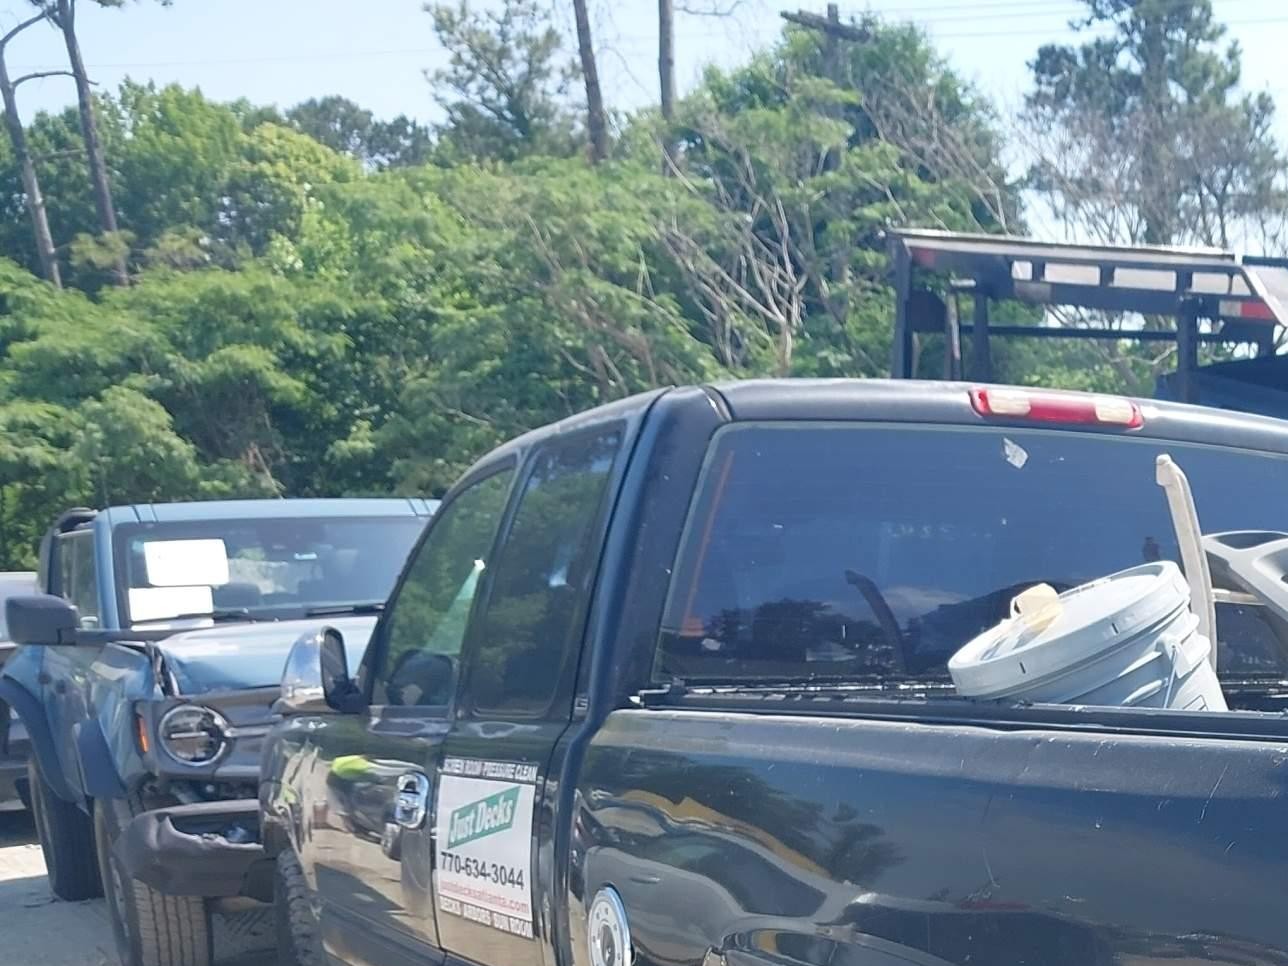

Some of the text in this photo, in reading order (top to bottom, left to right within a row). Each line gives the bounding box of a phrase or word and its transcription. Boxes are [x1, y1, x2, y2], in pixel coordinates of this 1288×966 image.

[482, 761, 515, 779] PRESSURE
[515, 764, 538, 782] CLEAN
[450, 795, 513, 843] Just Decks
[441, 850, 525, 891] 770-634-3044
